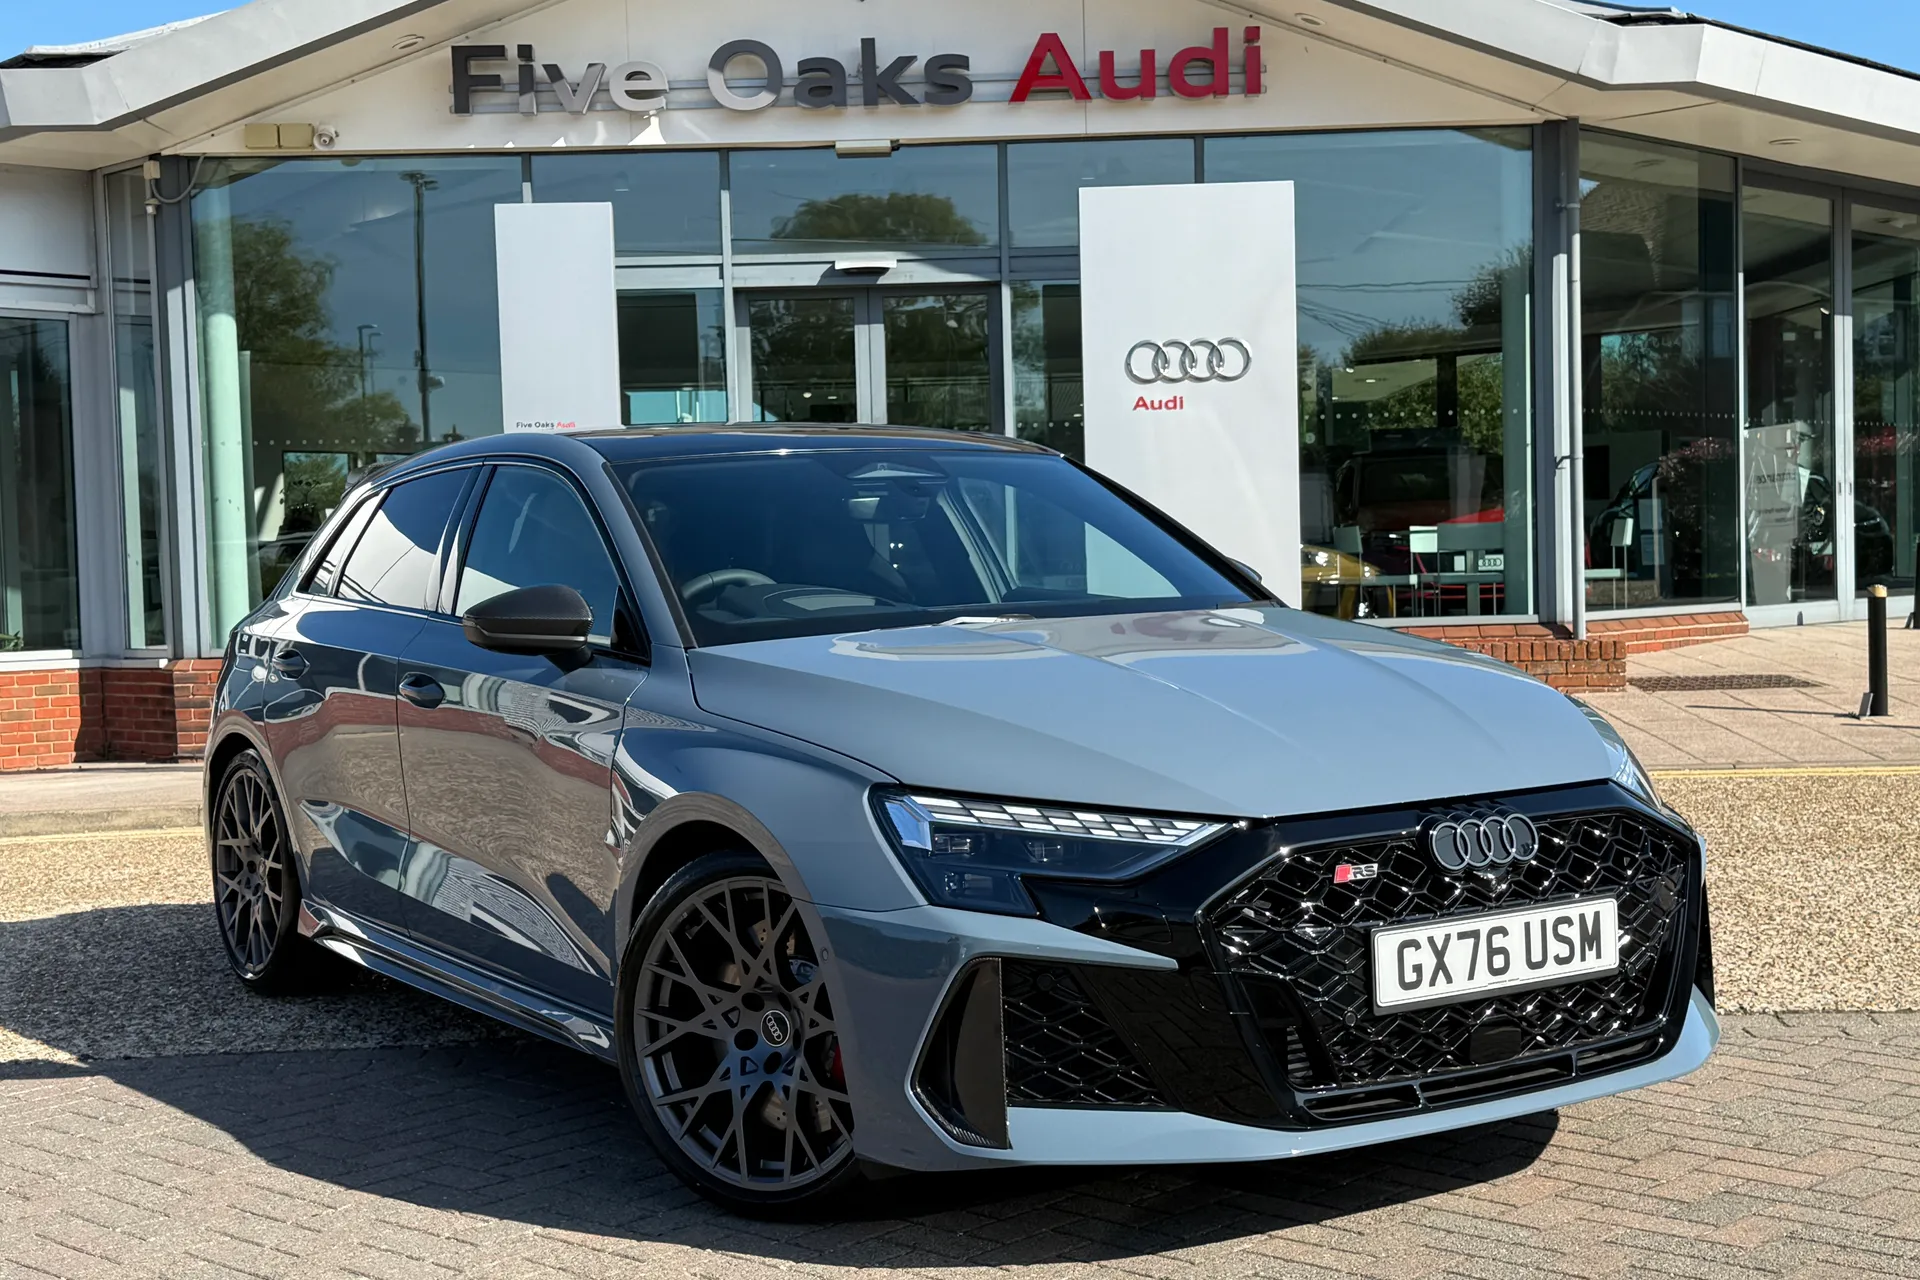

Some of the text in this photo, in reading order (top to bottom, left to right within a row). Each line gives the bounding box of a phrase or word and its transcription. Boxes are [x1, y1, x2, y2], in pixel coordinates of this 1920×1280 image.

[450, 26, 1262, 115] Five Oaks Audi
[1132, 395, 1184, 411] Audi
[534, 421, 555, 429] Oaks
[1351, 864, 1376, 879] RS
[1396, 910, 1602, 991] GX76 USM
